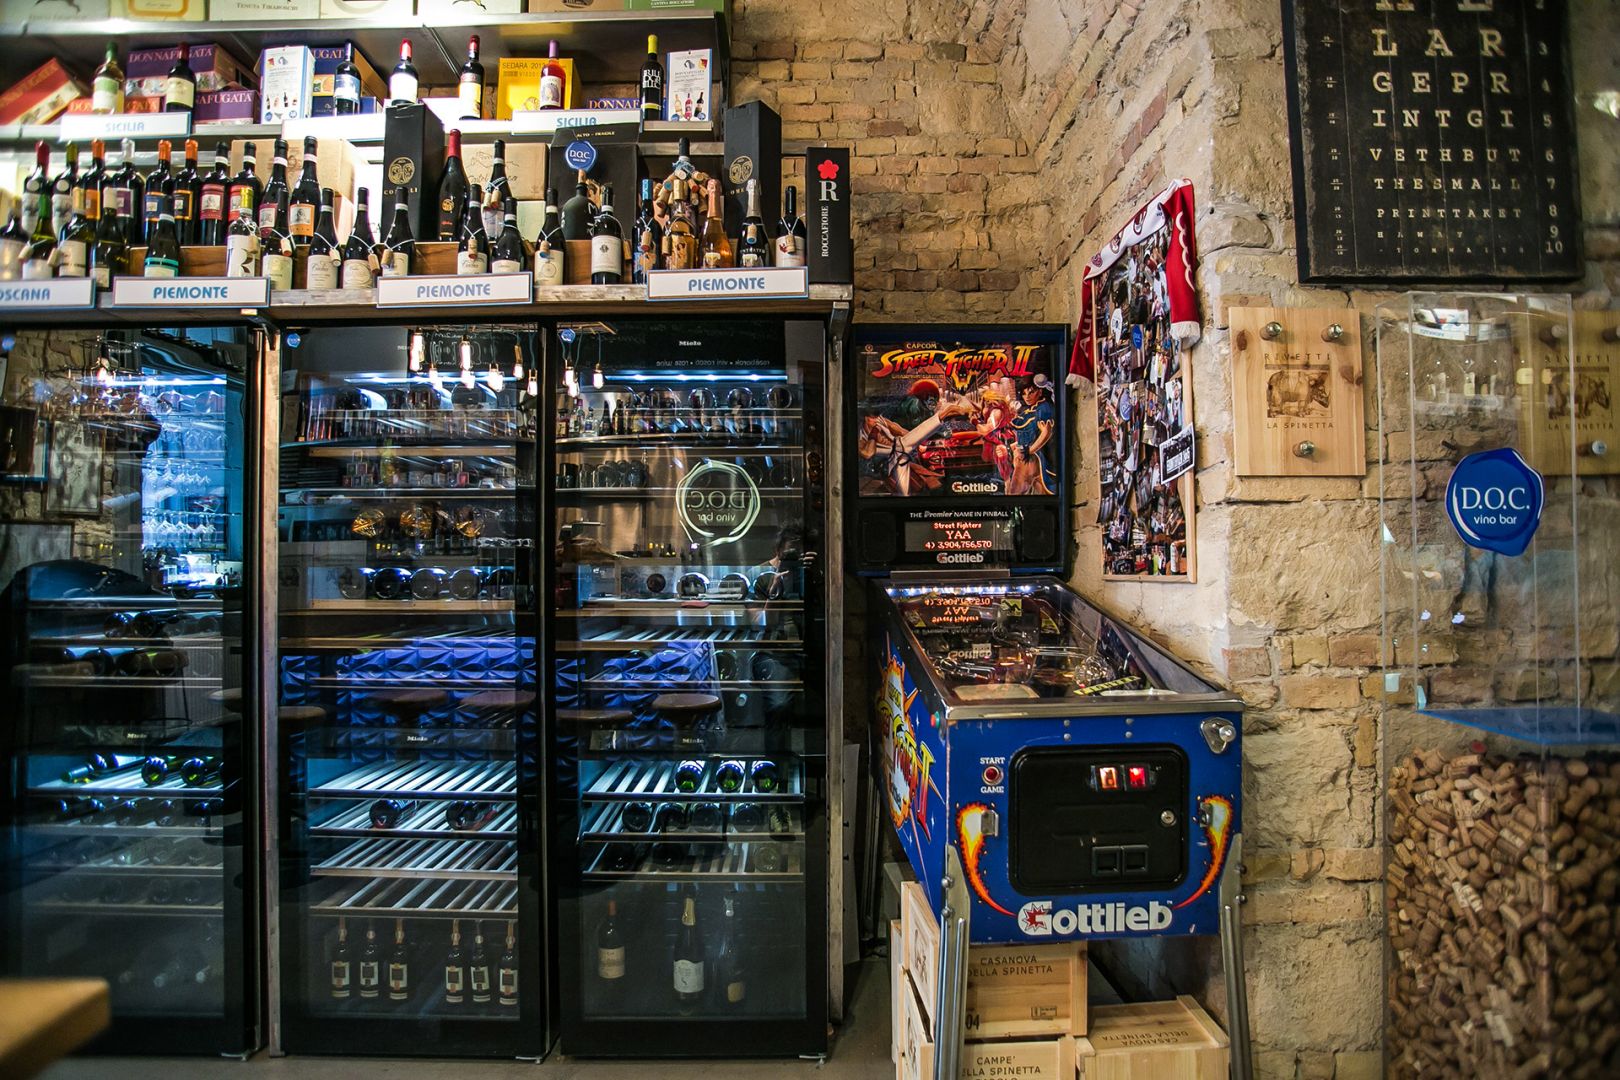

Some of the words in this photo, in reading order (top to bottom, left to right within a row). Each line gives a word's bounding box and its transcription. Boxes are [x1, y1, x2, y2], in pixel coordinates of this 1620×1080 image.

[1537, 41, 1548, 55] 3
[556, 116, 597, 128] SICILIA
[1542, 114, 1552, 127] 5
[105, 121, 145, 133] SICILIA
[1545, 150, 1554, 162] 6
[818, 180, 840, 202] R
[1548, 204, 1558, 217] 8
[820, 205, 829, 257] ROCCAFIORE
[1549, 226, 1559, 238] 9
[1545, 241, 1563, 253] 10
[687, 277, 766, 292] PIEMONTE
[152, 286, 229, 300] PIEMONTE
[416, 283, 492, 299] PIEMONTE
[1010, 345, 1042, 377] II
[1264, 351, 1331, 361] RIVETTI
[1266, 422, 1278, 430] LA
[1283, 421, 1334, 430] SPINETTA
[1565, 422, 1614, 431] SINETTA
[951, 481, 999, 493] Gottlieb
[1460, 487, 1531, 511] D.O.C.
[1474, 514, 1497, 525] vino
[1499, 512, 1518, 525] bar
[945, 530, 972, 540] YAA
[936, 551, 984, 564] Gottlieb
[979, 756, 1006, 765] START
[980, 785, 1005, 794] GAME
[1016, 900, 1173, 936] Gottlieb
[980, 955, 1037, 966] CASANOVA
[968, 968, 998, 977] DELLA
[1002, 965, 1053, 976] SPINETTA
[1120, 1037, 1178, 1047] CASANOVA
[976, 1055, 1016, 1066] CAMPE'
[961, 1067, 985, 1077] ELLA
[990, 1065, 1041, 1076] SPINETTA
